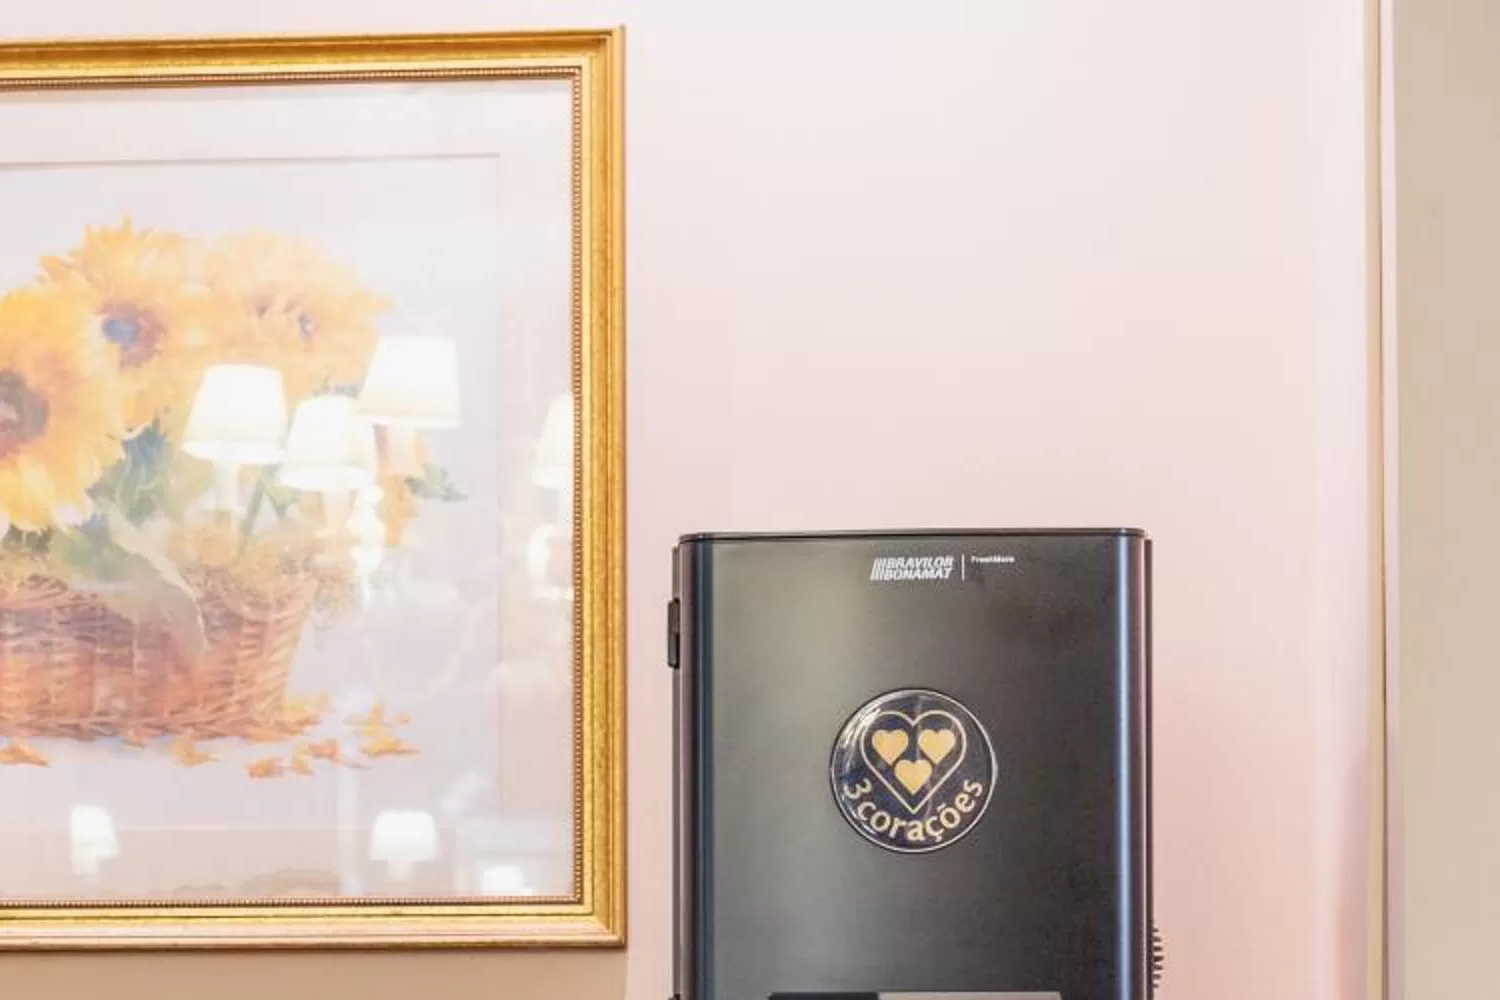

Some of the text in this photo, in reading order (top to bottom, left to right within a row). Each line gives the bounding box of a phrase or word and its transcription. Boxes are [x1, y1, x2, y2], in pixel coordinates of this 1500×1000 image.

[883, 568, 952, 580] BONAMAT
[843, 778, 984, 842] 3 corações
